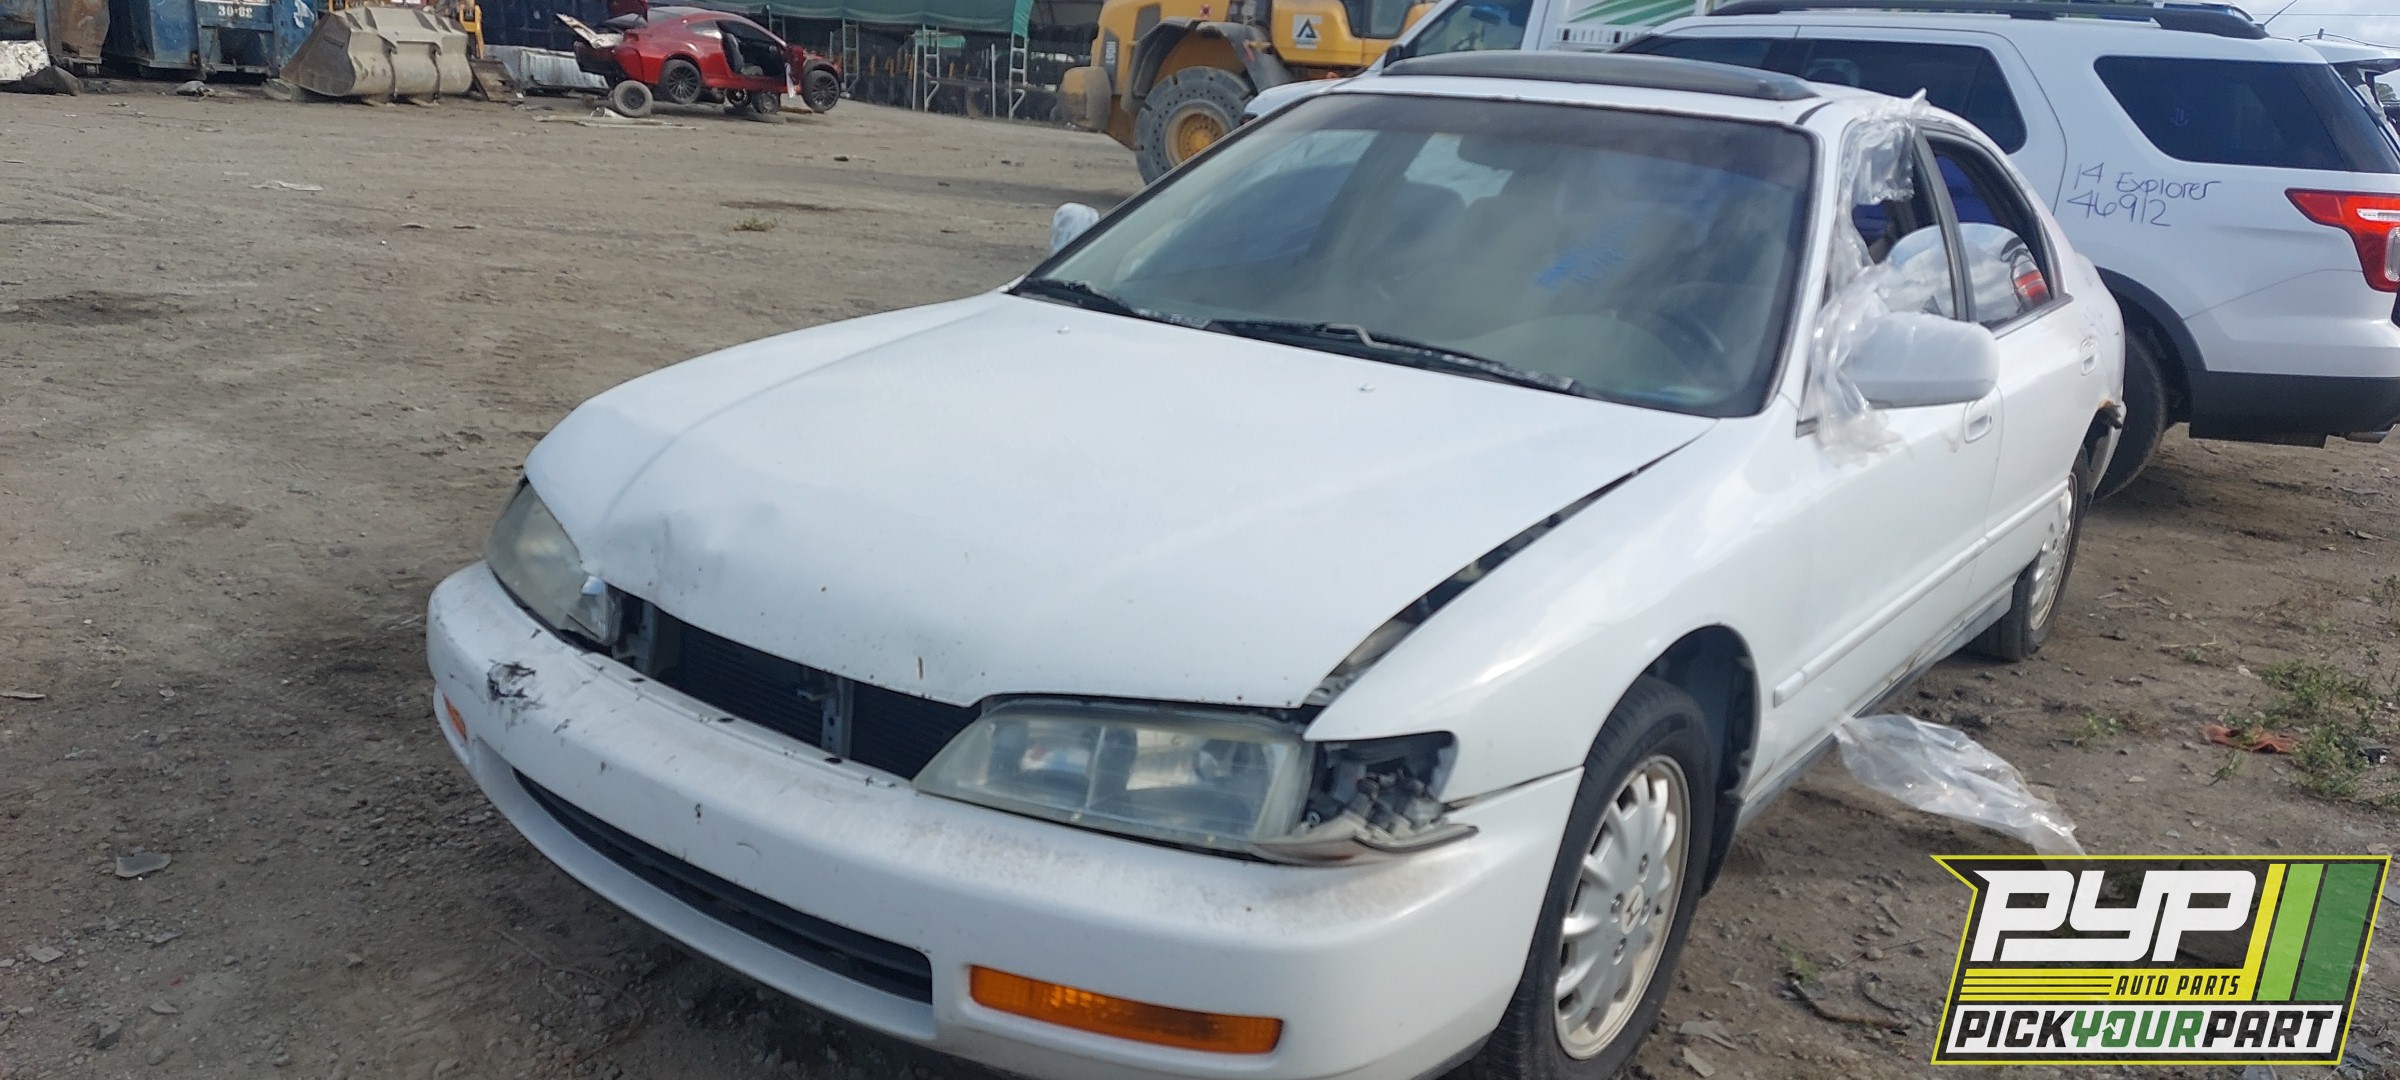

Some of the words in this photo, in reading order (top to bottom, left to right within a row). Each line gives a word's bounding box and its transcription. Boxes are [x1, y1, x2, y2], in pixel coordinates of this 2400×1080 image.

[2074, 162, 2105, 190] 14
[2116, 172, 2222, 200] Explorer
[2067, 189, 2172, 227] 46912
